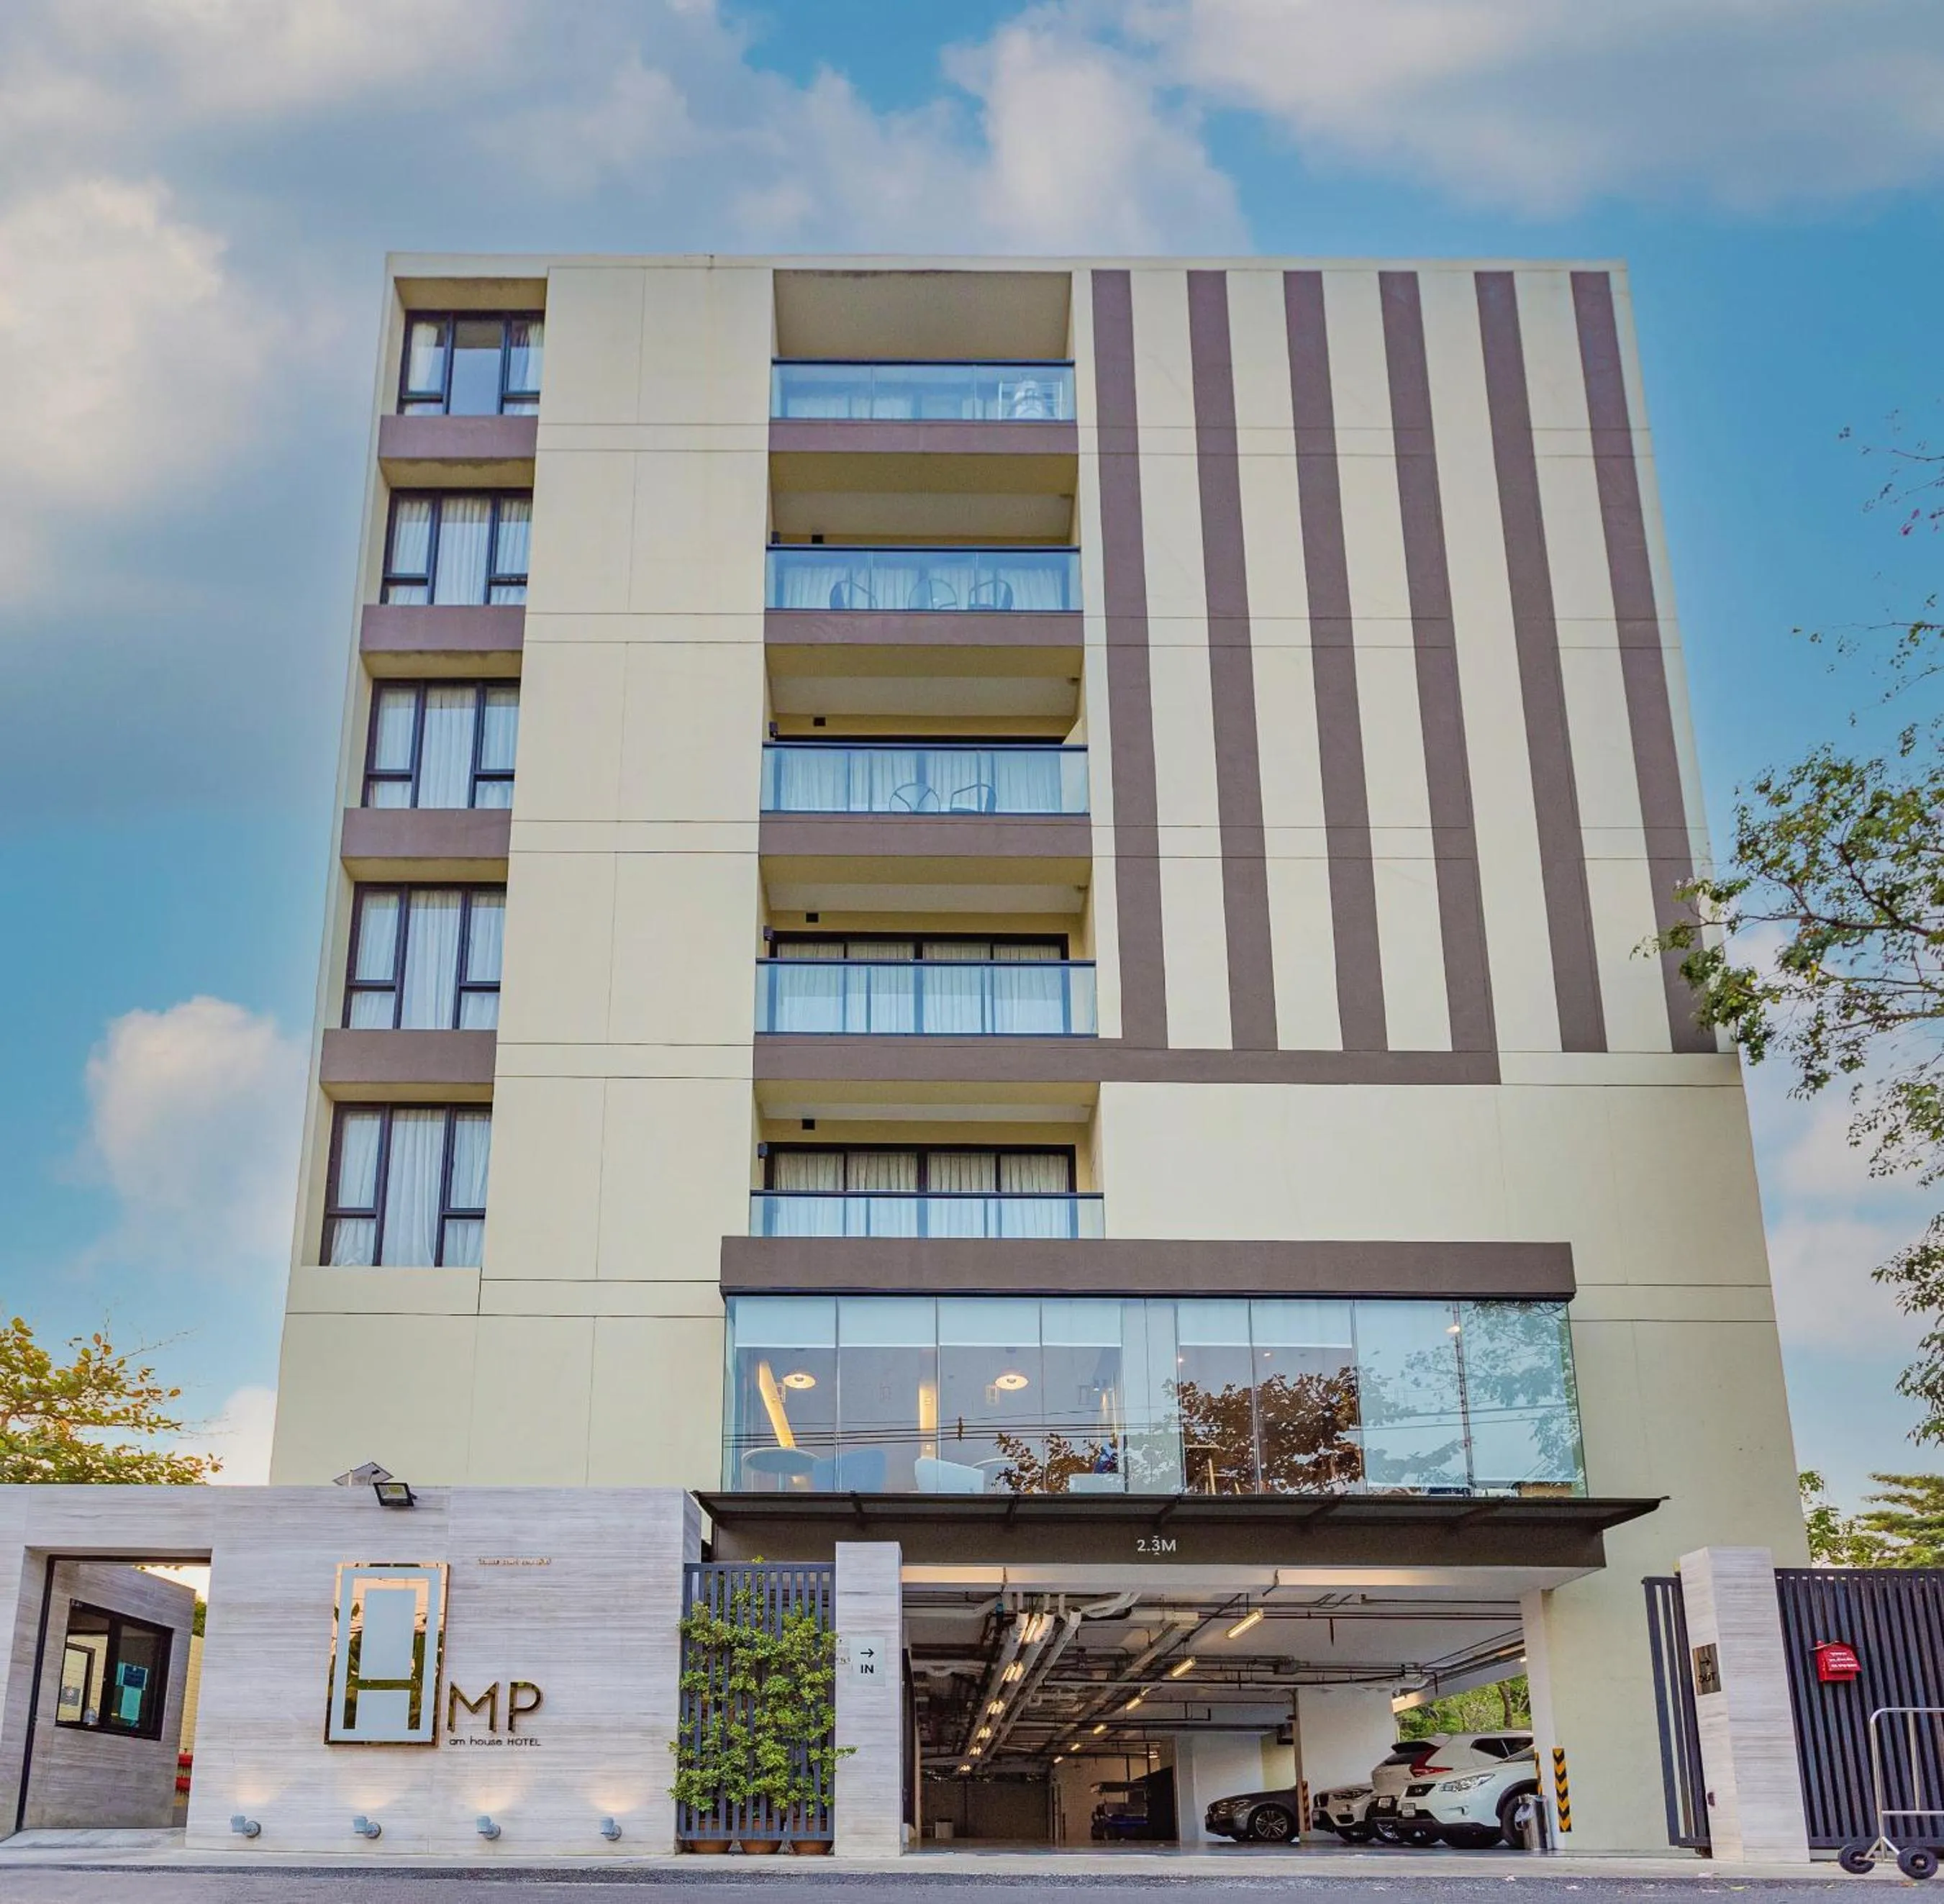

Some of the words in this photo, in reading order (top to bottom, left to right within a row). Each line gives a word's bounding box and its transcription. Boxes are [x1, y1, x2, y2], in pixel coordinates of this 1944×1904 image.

[1137, 1539, 1176, 1552] 2.3M
[860, 1664, 874, 1674] IN
[1699, 1672, 1716, 1684] OUT
[470, 1736, 502, 1746] house
[507, 1738, 542, 1746] HOTEL
